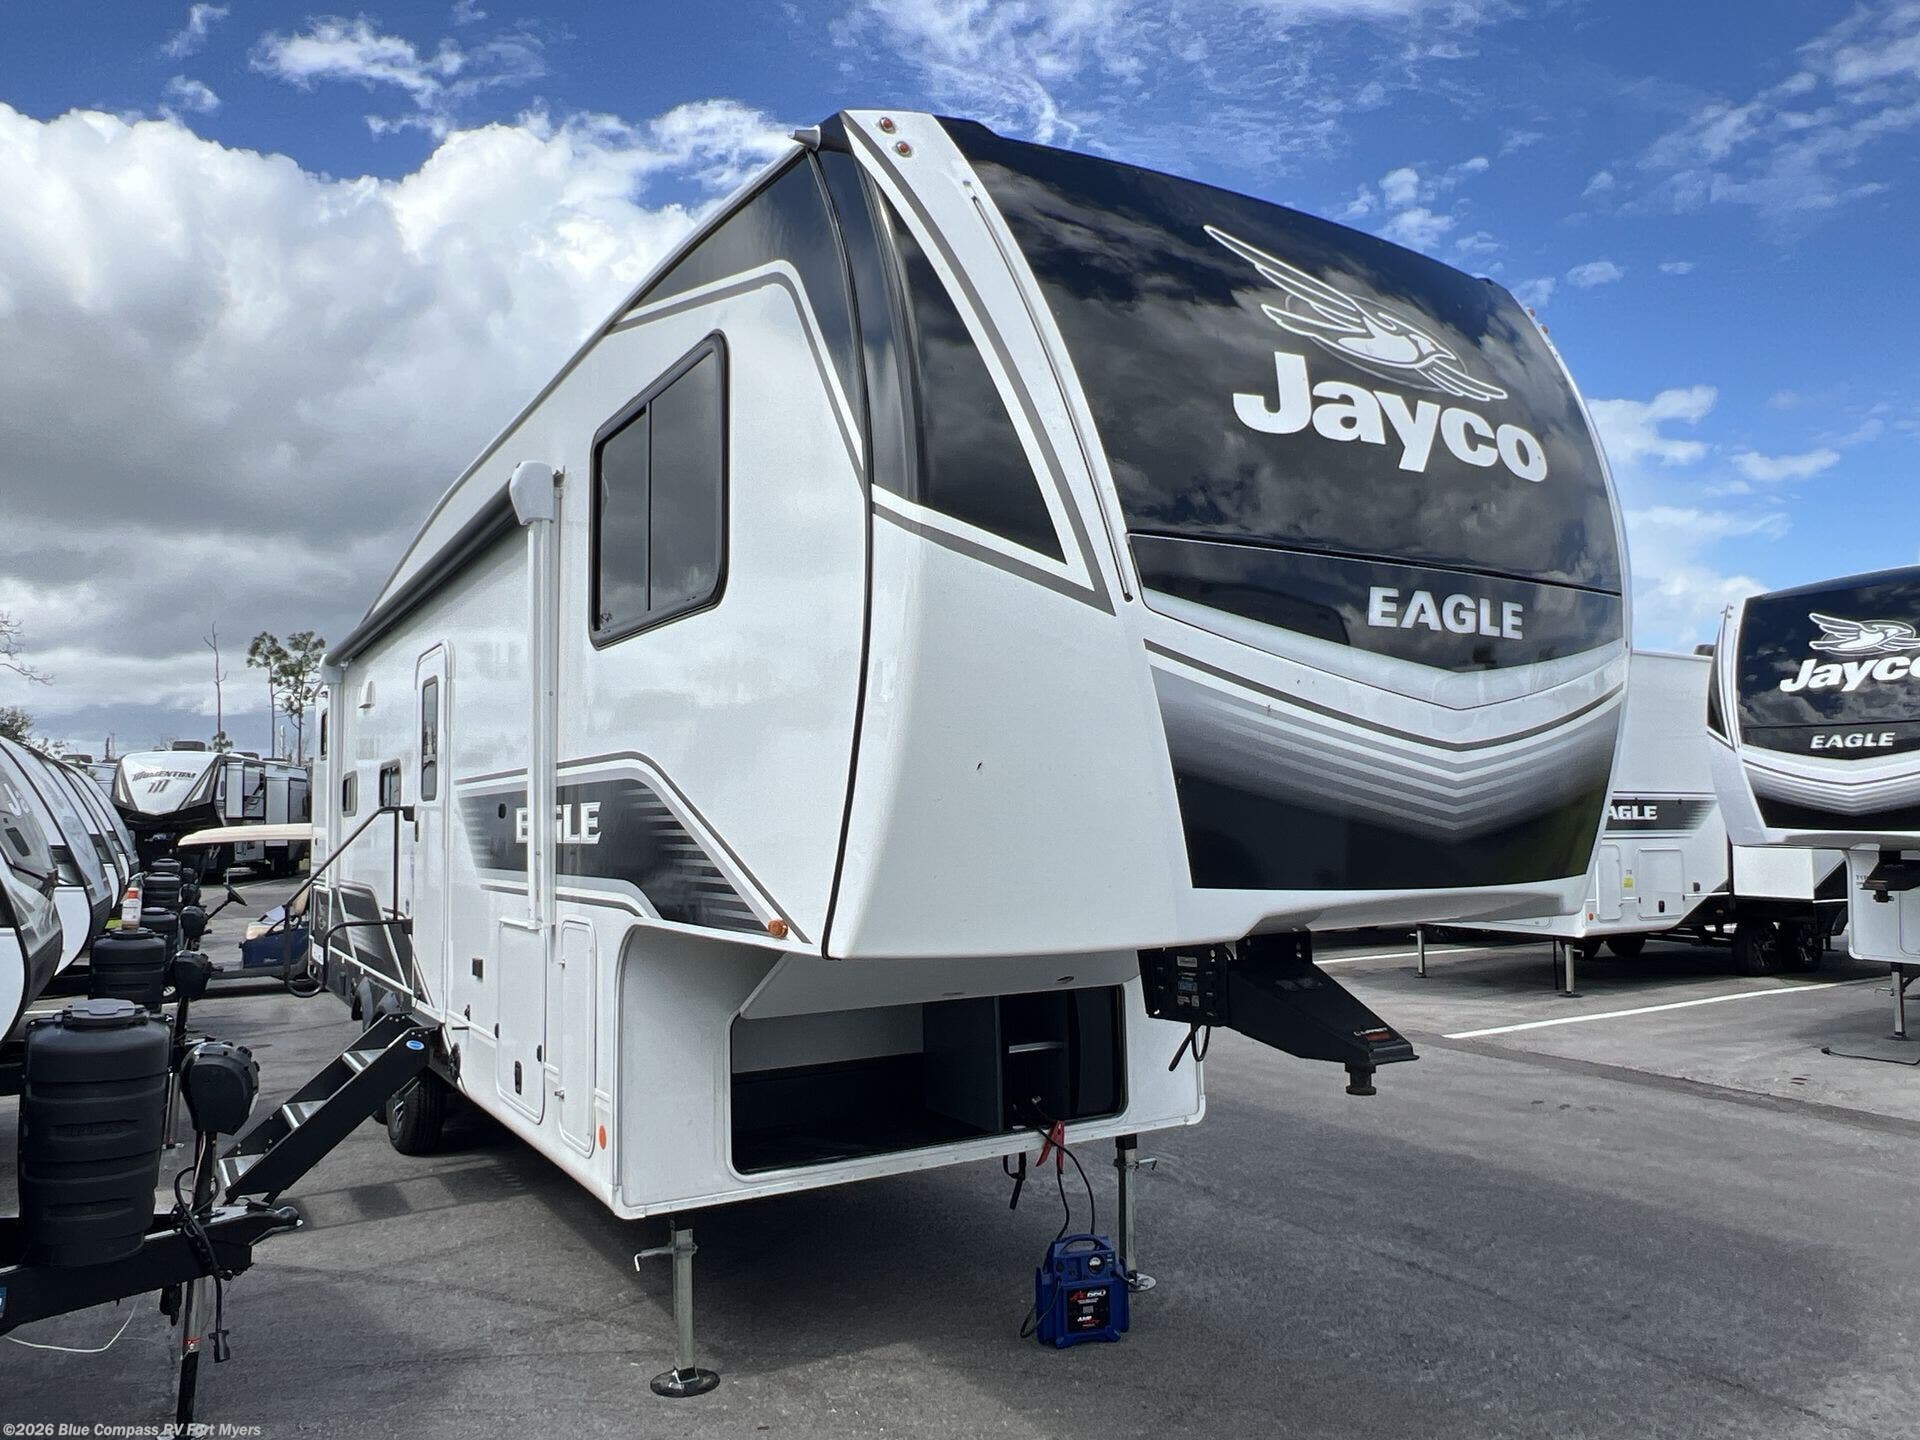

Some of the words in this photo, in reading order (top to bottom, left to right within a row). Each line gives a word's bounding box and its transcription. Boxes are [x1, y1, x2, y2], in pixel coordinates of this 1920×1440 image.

[1233, 351, 1548, 482] Jayco
[1367, 586, 1523, 640] EAGLE
[1810, 732, 1896, 749] EAGLE
[515, 801, 602, 844] ELE
[1608, 805, 1658, 820] AGLE
